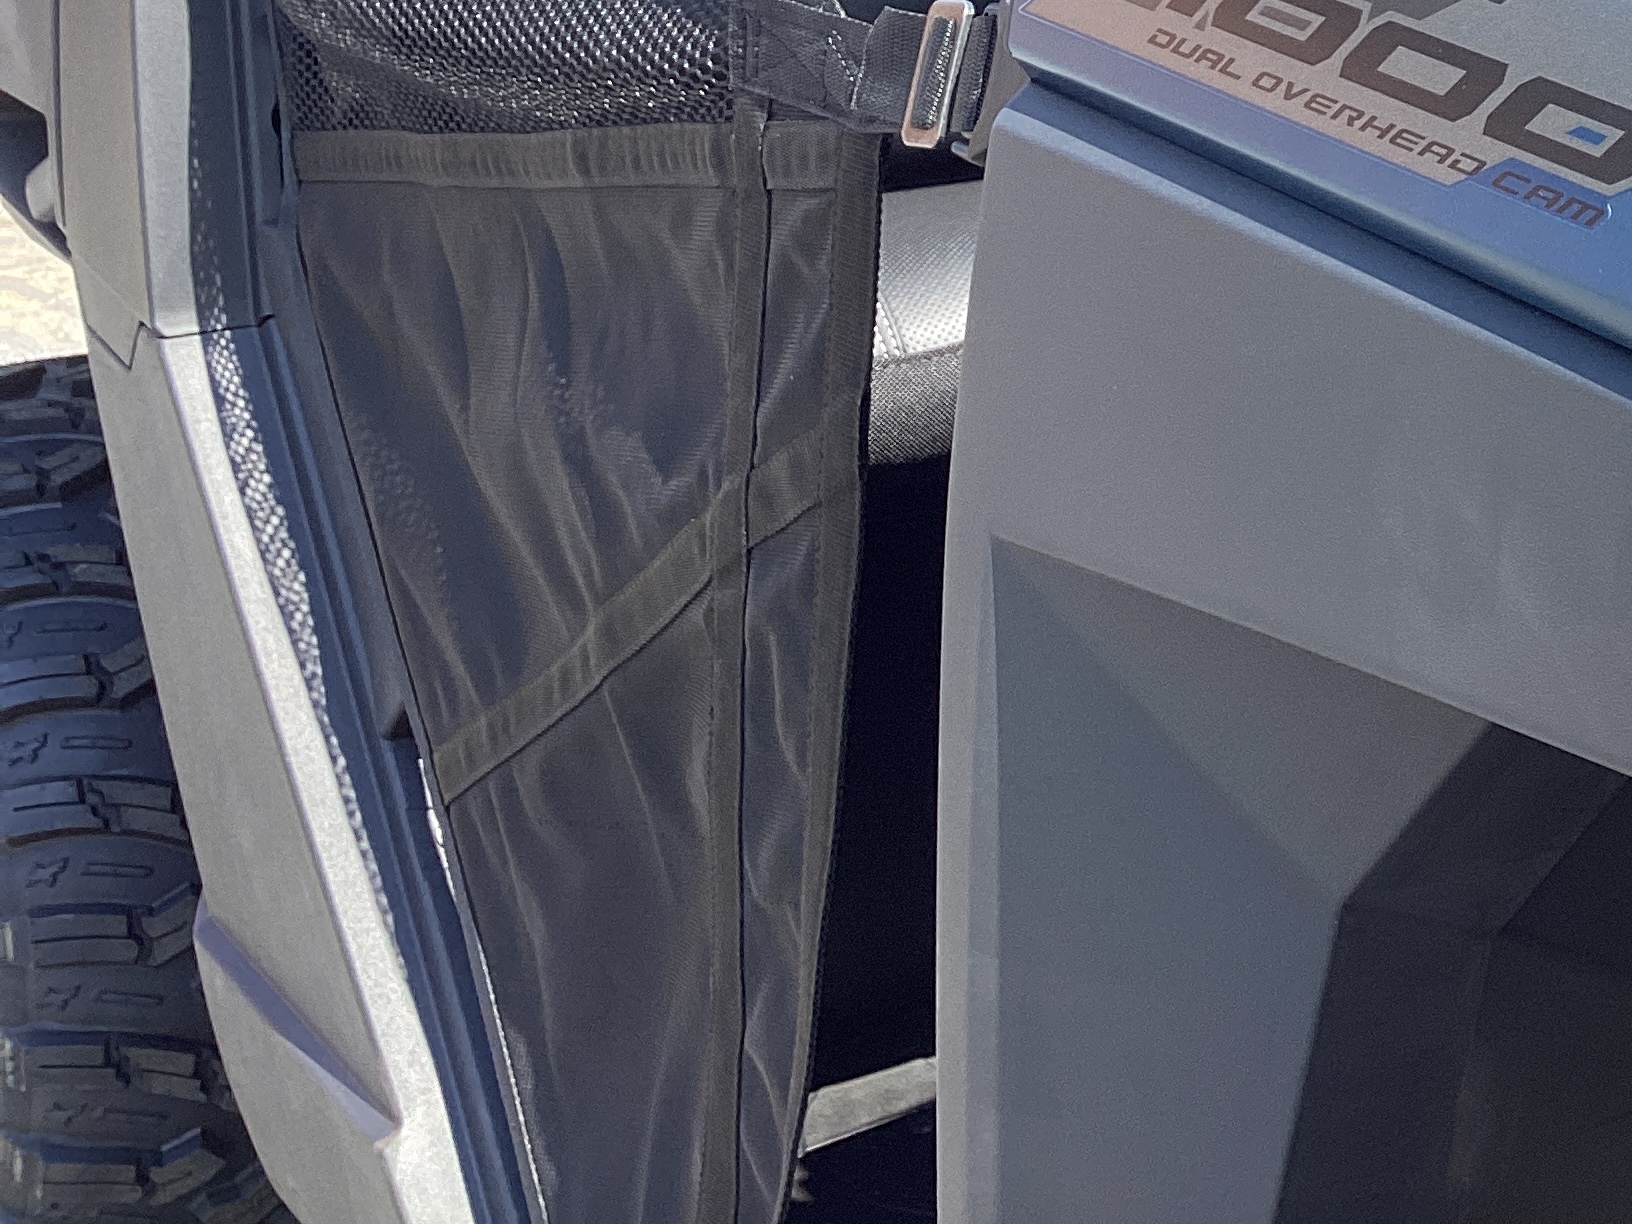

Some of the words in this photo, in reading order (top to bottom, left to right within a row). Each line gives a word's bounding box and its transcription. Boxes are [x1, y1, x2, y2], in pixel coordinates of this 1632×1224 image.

[1147, 27, 1242, 81] DUAL
[1251, 71, 1487, 176] OVERHEAD
[1491, 169, 1610, 229] CAM
